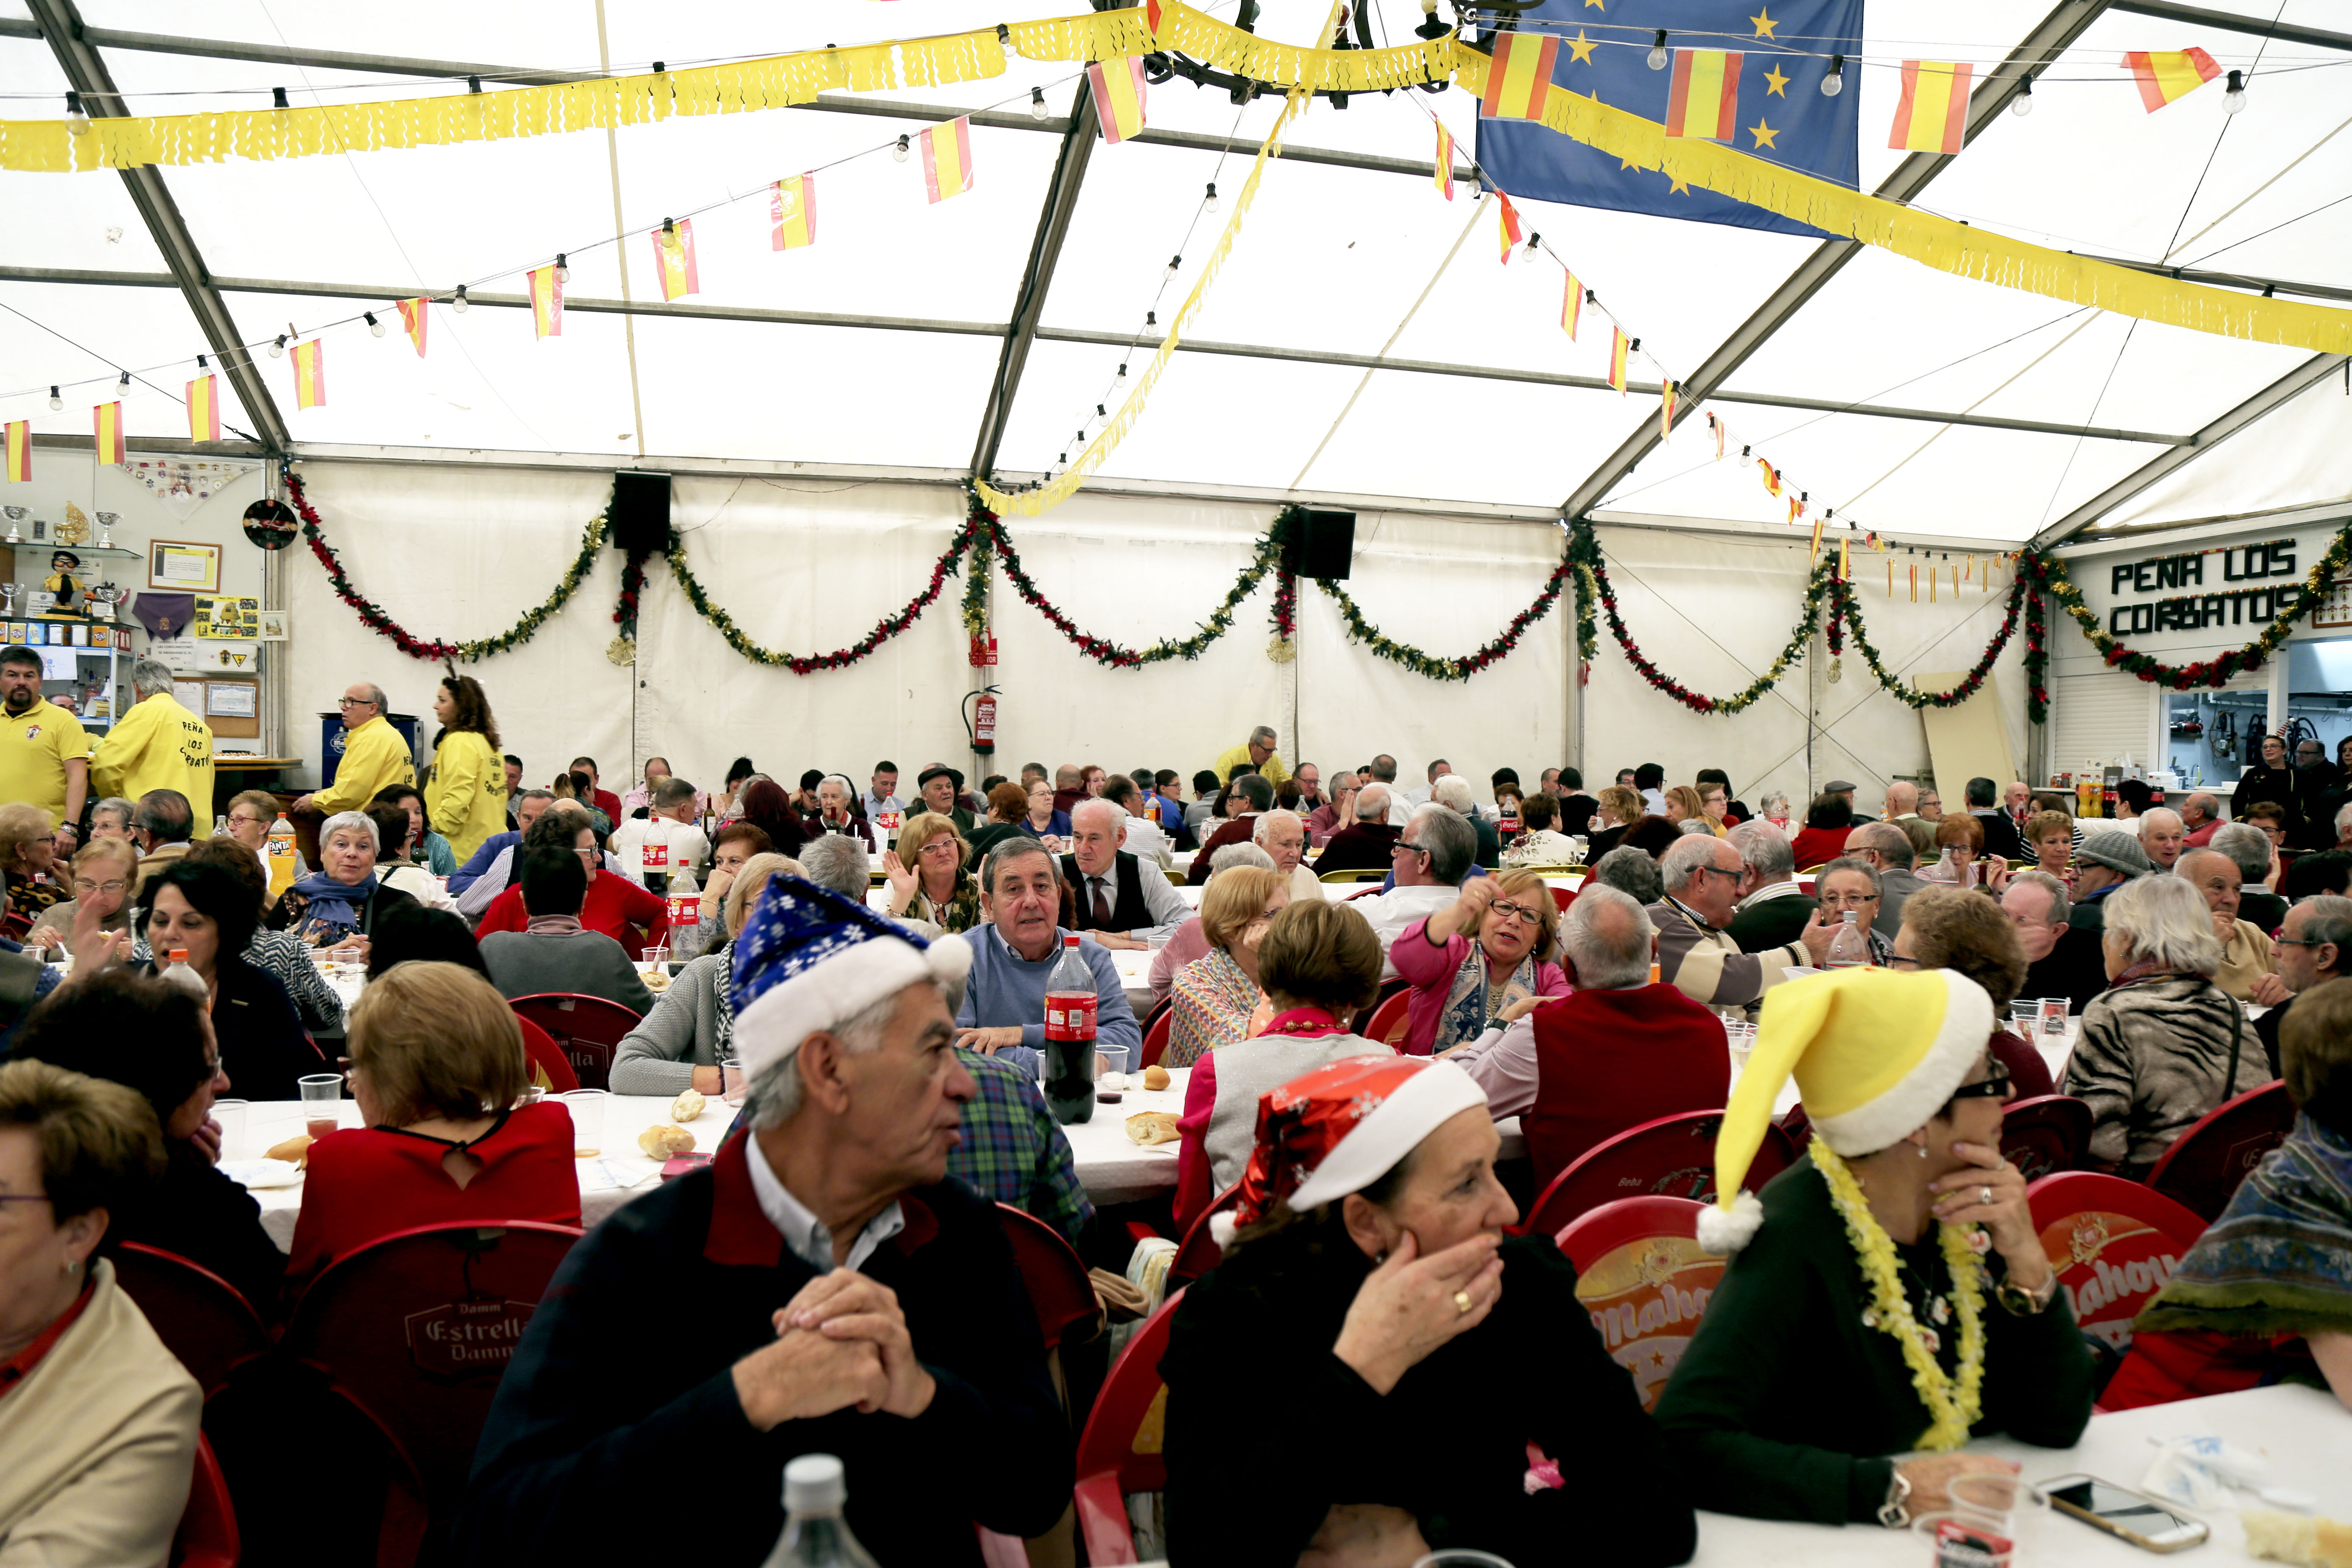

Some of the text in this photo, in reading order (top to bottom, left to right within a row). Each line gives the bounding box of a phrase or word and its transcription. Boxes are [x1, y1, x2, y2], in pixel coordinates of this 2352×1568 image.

[2224, 541, 2296, 581] LOS
[182, 722, 202, 735] PEÑA
[188, 739, 202, 750] LOS
[180, 747, 209, 767] CRBATO
[269, 841, 290, 851] FANTA
[1618, 1177, 1643, 1187] Beba
[459, 1303, 501, 1314] Damm
[1590, 1284, 1715, 1350] Maho
